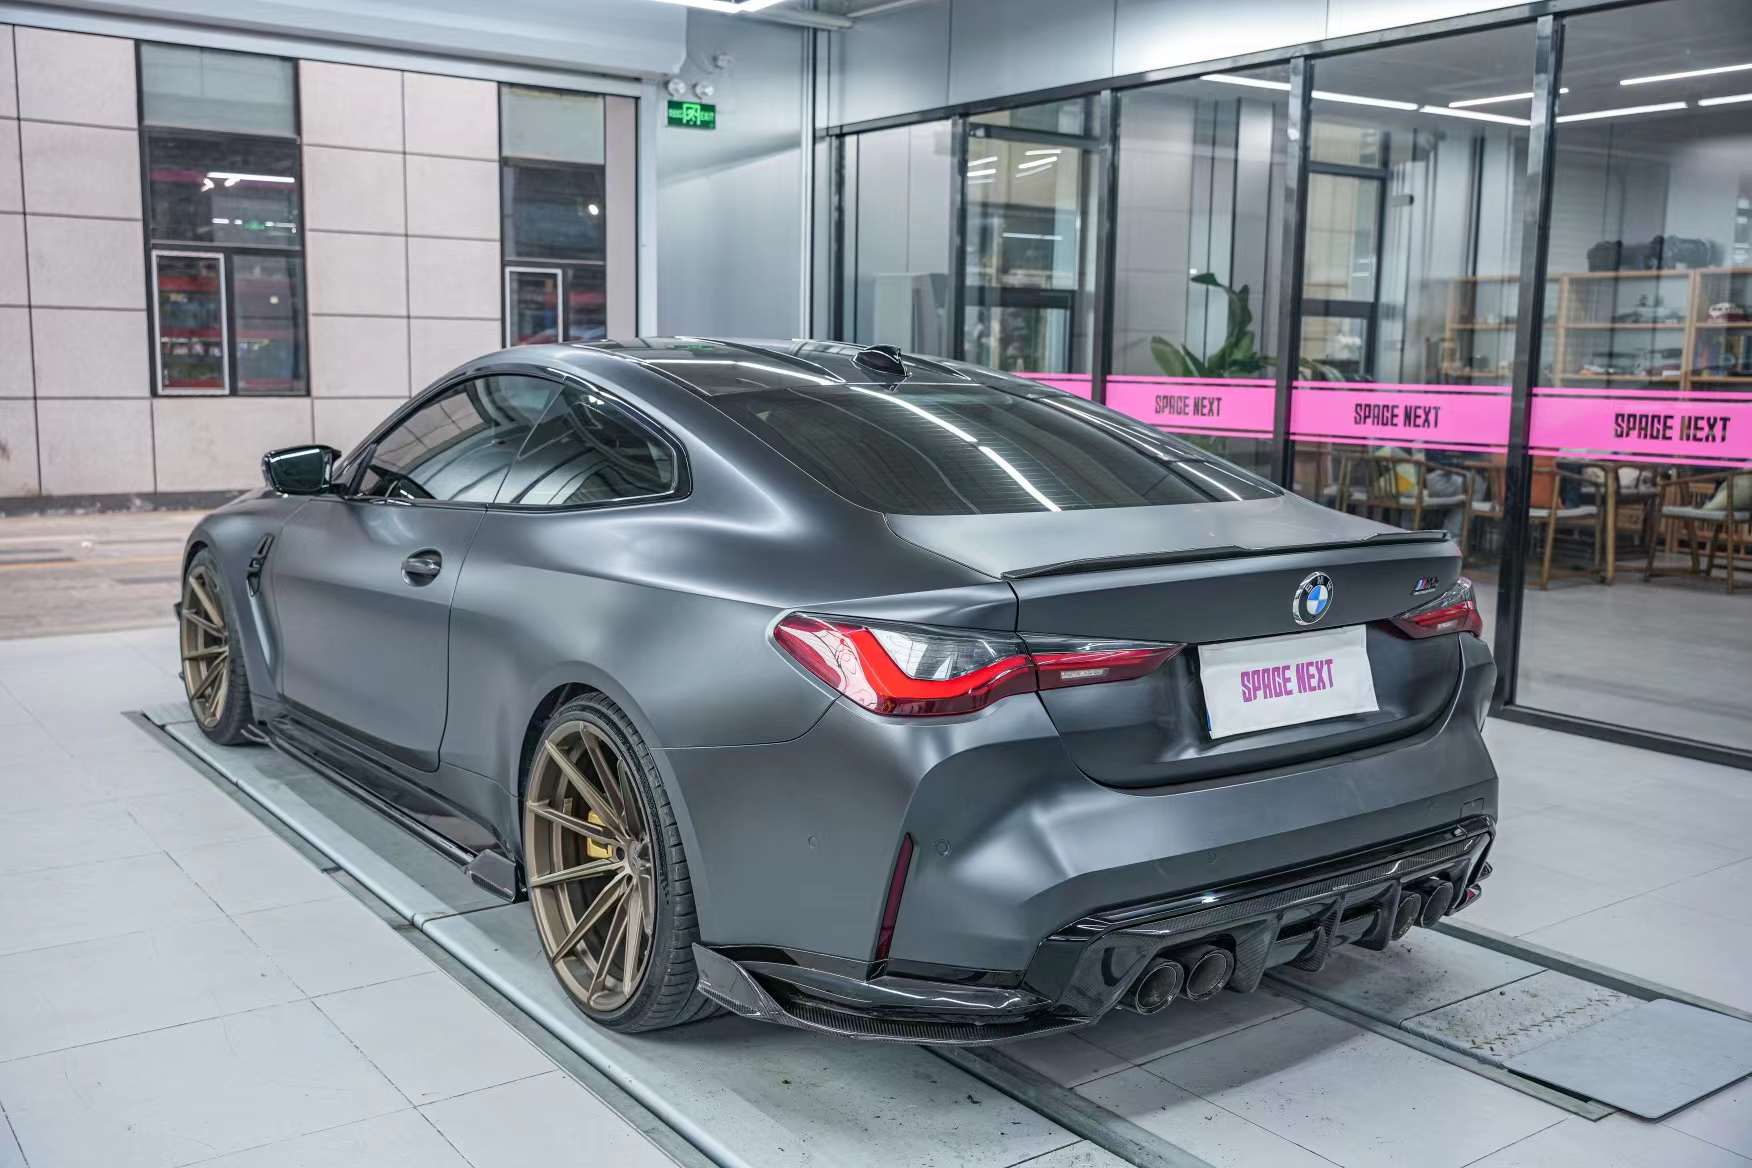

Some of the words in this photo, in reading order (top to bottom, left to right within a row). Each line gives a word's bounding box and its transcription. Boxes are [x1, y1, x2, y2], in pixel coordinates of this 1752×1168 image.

[1193, 396, 1222, 417] NEXT
[1403, 405, 1441, 429] NEXT
[1679, 415, 1731, 443] NEXT
[1295, 658, 1334, 693] NEXT
